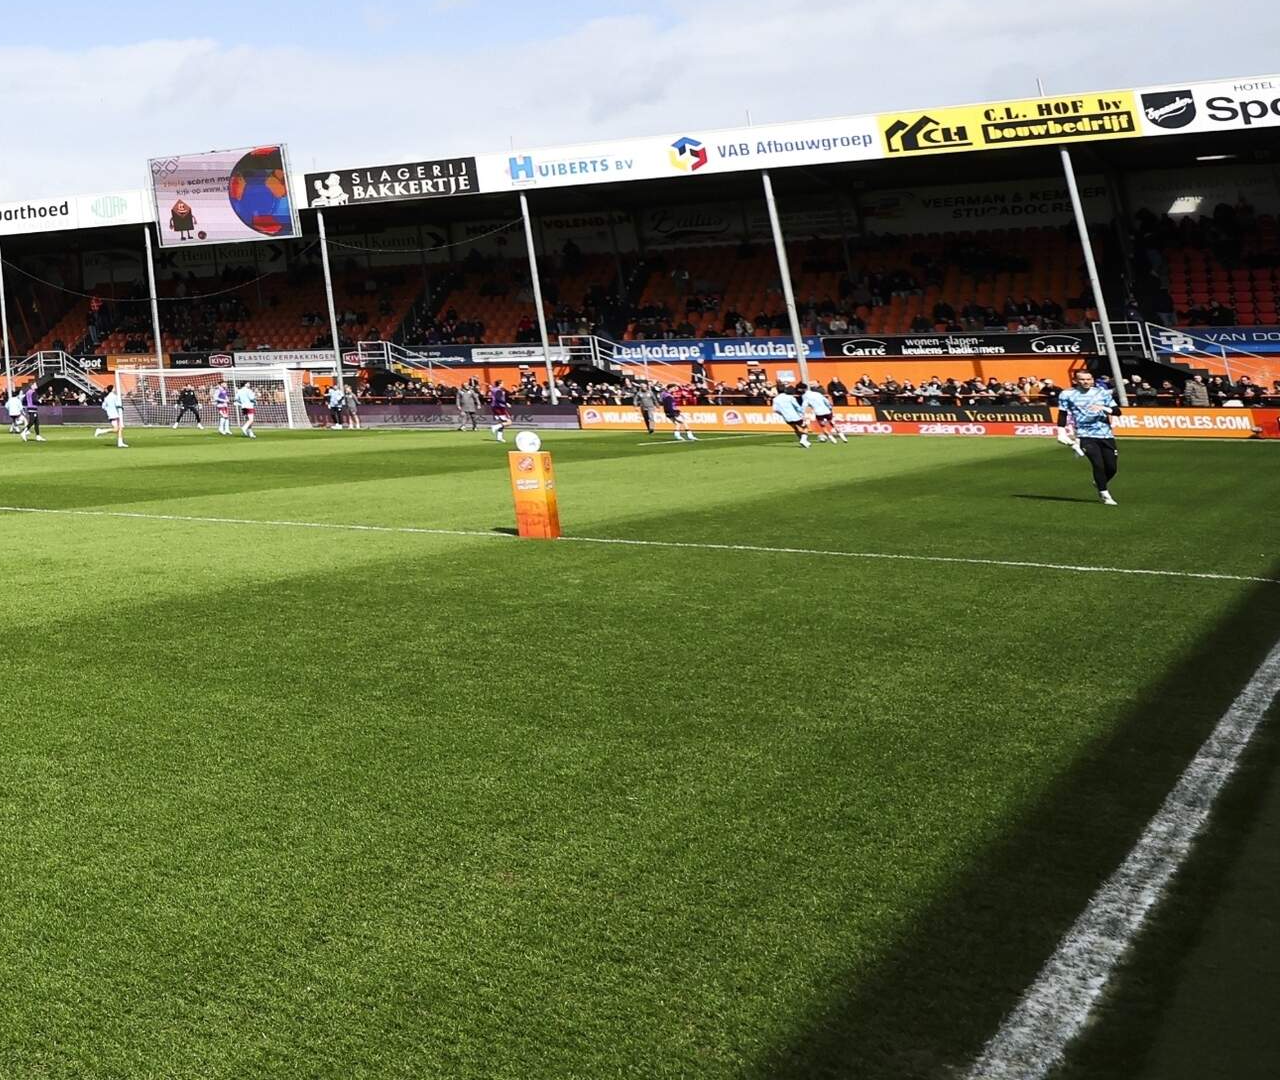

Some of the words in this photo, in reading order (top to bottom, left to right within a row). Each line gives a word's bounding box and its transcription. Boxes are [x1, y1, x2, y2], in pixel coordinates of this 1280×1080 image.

[1234, 81, 1276, 92] HOTEL
[983, 106, 1028, 122] C.L.
[1037, 100, 1084, 116] HOF
[1098, 98, 1122, 111] bv
[988, 113, 1130, 141] bouwbedrijf
[717, 143, 751, 158] VAB
[756, 133, 873, 154] Afbouwgroep
[351, 162, 466, 185] SLAGERIJ
[509, 155, 609, 180] HUIBERTS
[615, 159, 634, 170] BV
[187, 177, 215, 186] scoren
[352, 175, 471, 200] BAKKERTJE
[922, 192, 1005, 208] VEERMAN
[1029, 186, 1107, 203] KEMER
[1205, 332, 1246, 341] VAN
[842, 344, 886, 357] Carré
[1031, 340, 1081, 354] Carré
[78, 357, 102, 369] Spot
[211, 357, 229, 365] KIVO
[273, 352, 336, 361] VERPAKKINGEN
[882, 409, 957, 422] Veerman
[964, 410, 1044, 423] Veerman
[918, 423, 987, 435] zalando
